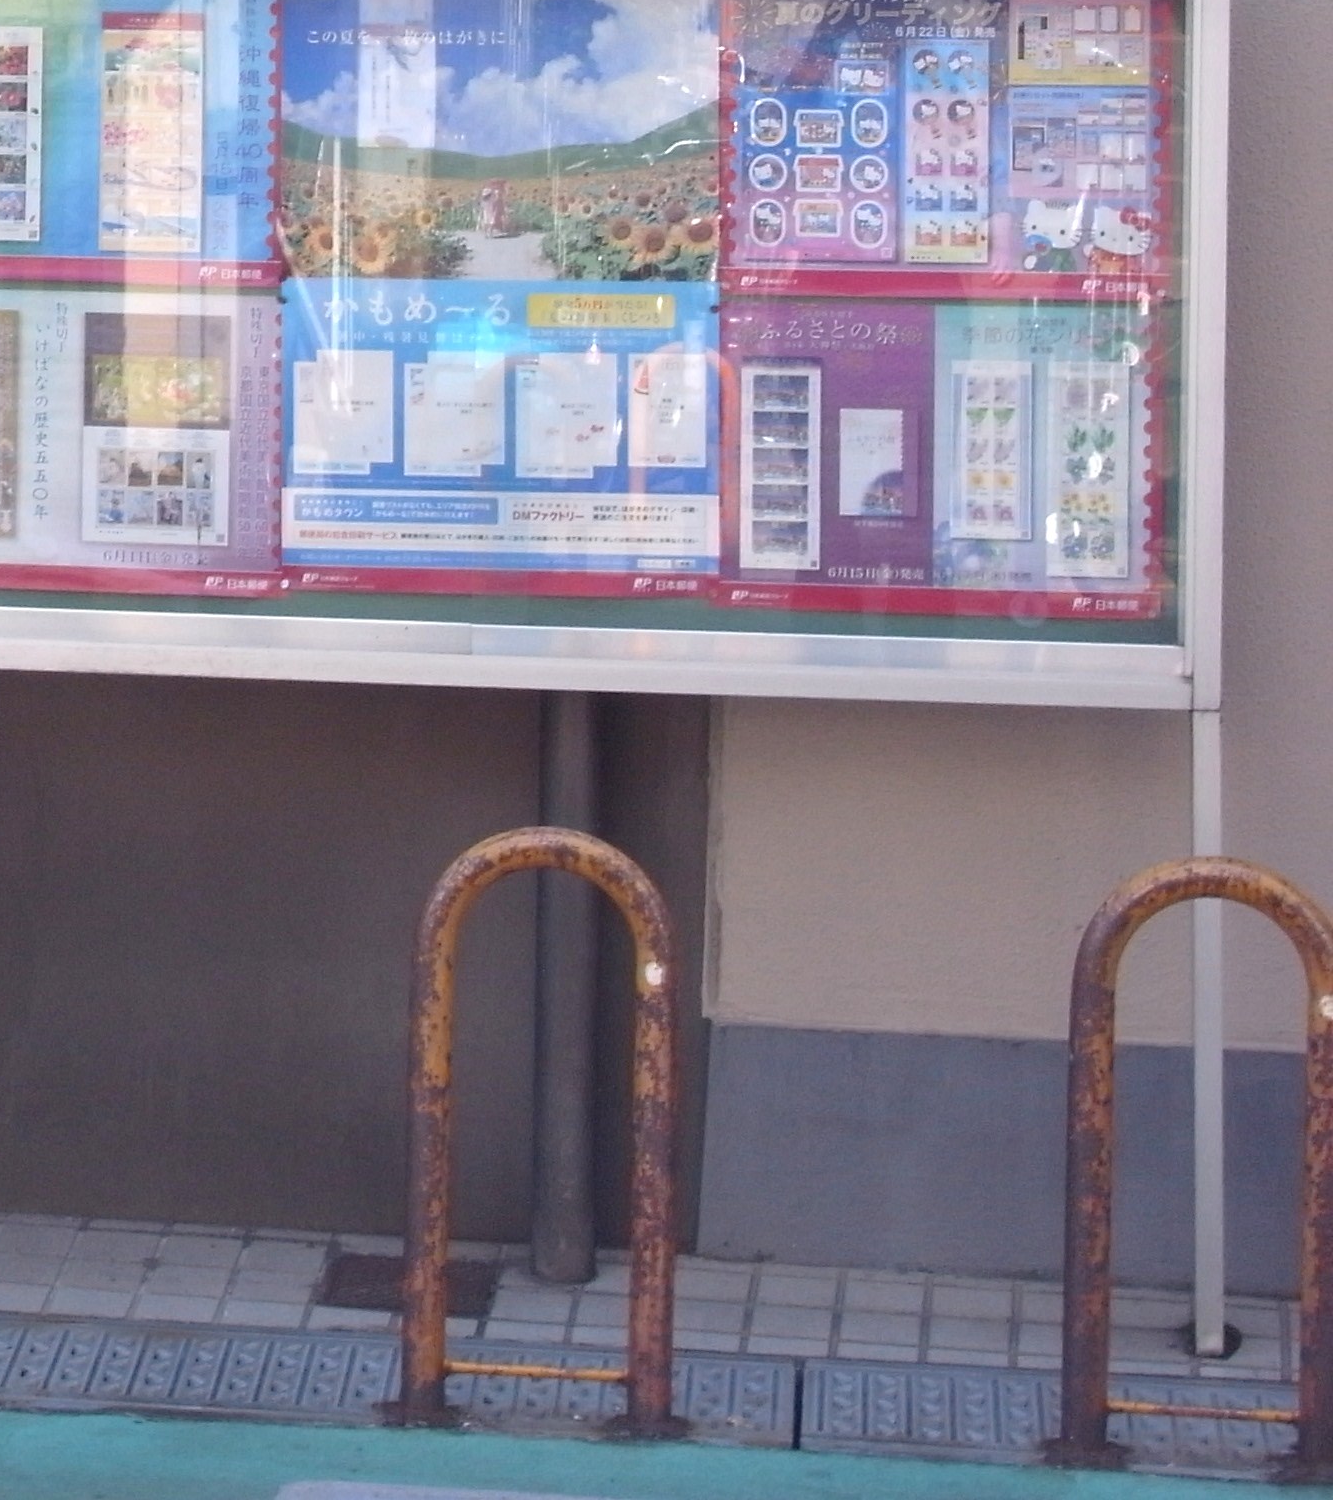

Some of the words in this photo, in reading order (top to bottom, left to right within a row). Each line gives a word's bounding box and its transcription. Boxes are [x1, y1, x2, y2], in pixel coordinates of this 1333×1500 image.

[775, 0, 1003, 26] 夏のグリーティング
[760, 319, 898, 345] ふるさとの祭
[32, 323, 48, 520] いけばなの歴史五五〇年
[512, 510, 585, 521] DMファクトリー
[656, 580, 698, 591] 日本郵便
